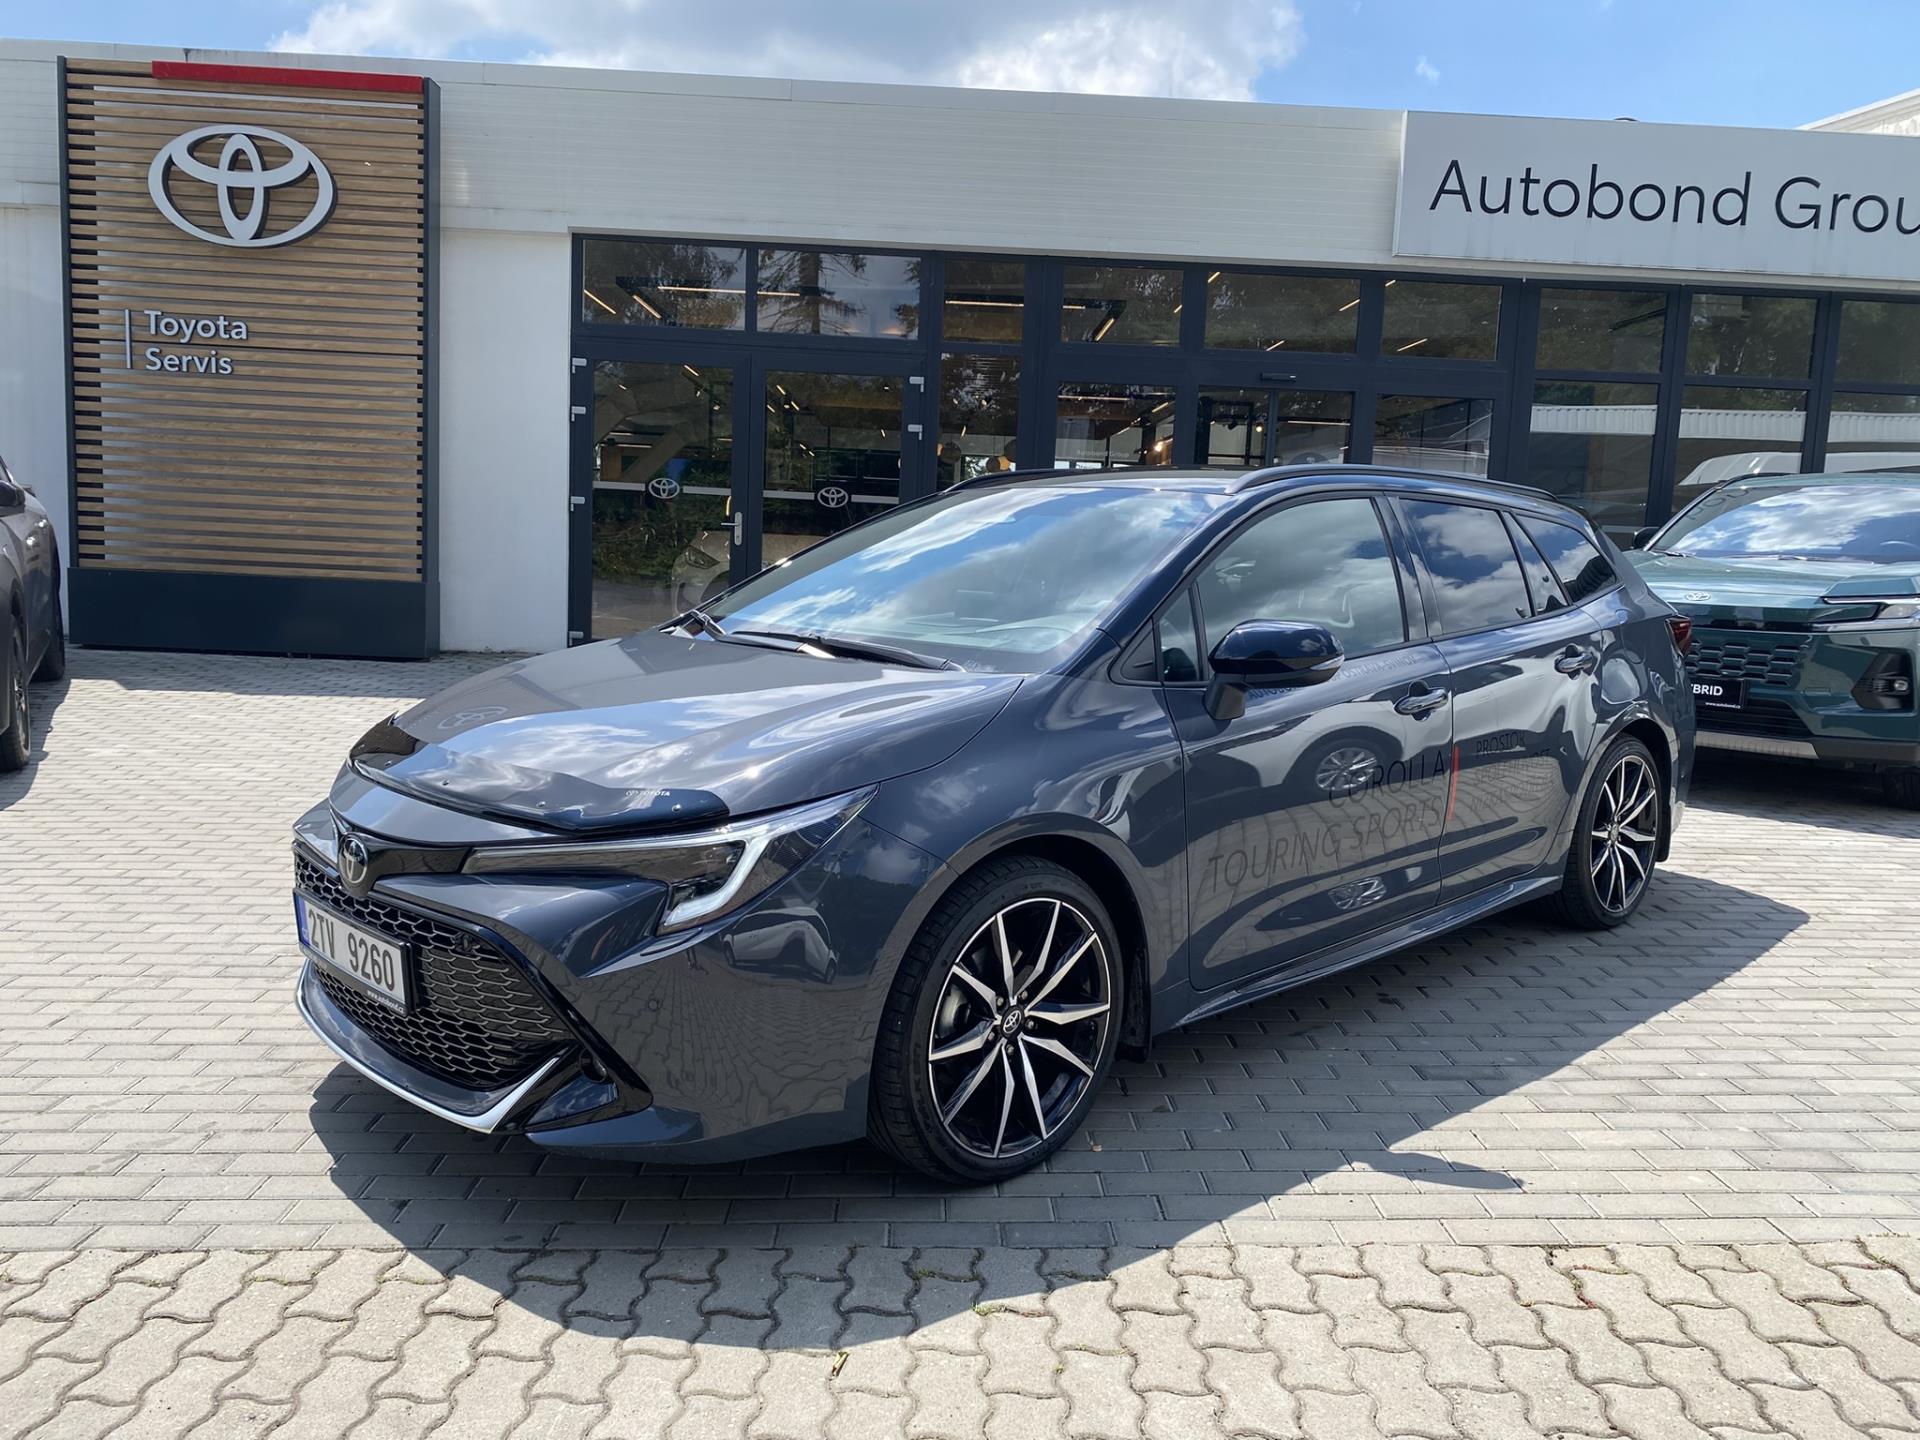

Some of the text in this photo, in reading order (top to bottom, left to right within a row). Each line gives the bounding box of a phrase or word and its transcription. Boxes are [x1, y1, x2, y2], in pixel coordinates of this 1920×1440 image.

[1429, 159, 1752, 227] Autobond
[143, 309, 248, 344] Toyota
[145, 347, 233, 375] Servis
[1690, 683, 1724, 696] BRID
[1328, 750, 1446, 809] COROLLA
[1208, 796, 1442, 893] TOURING SPORTS
[308, 908, 395, 992] 2TV 9260
